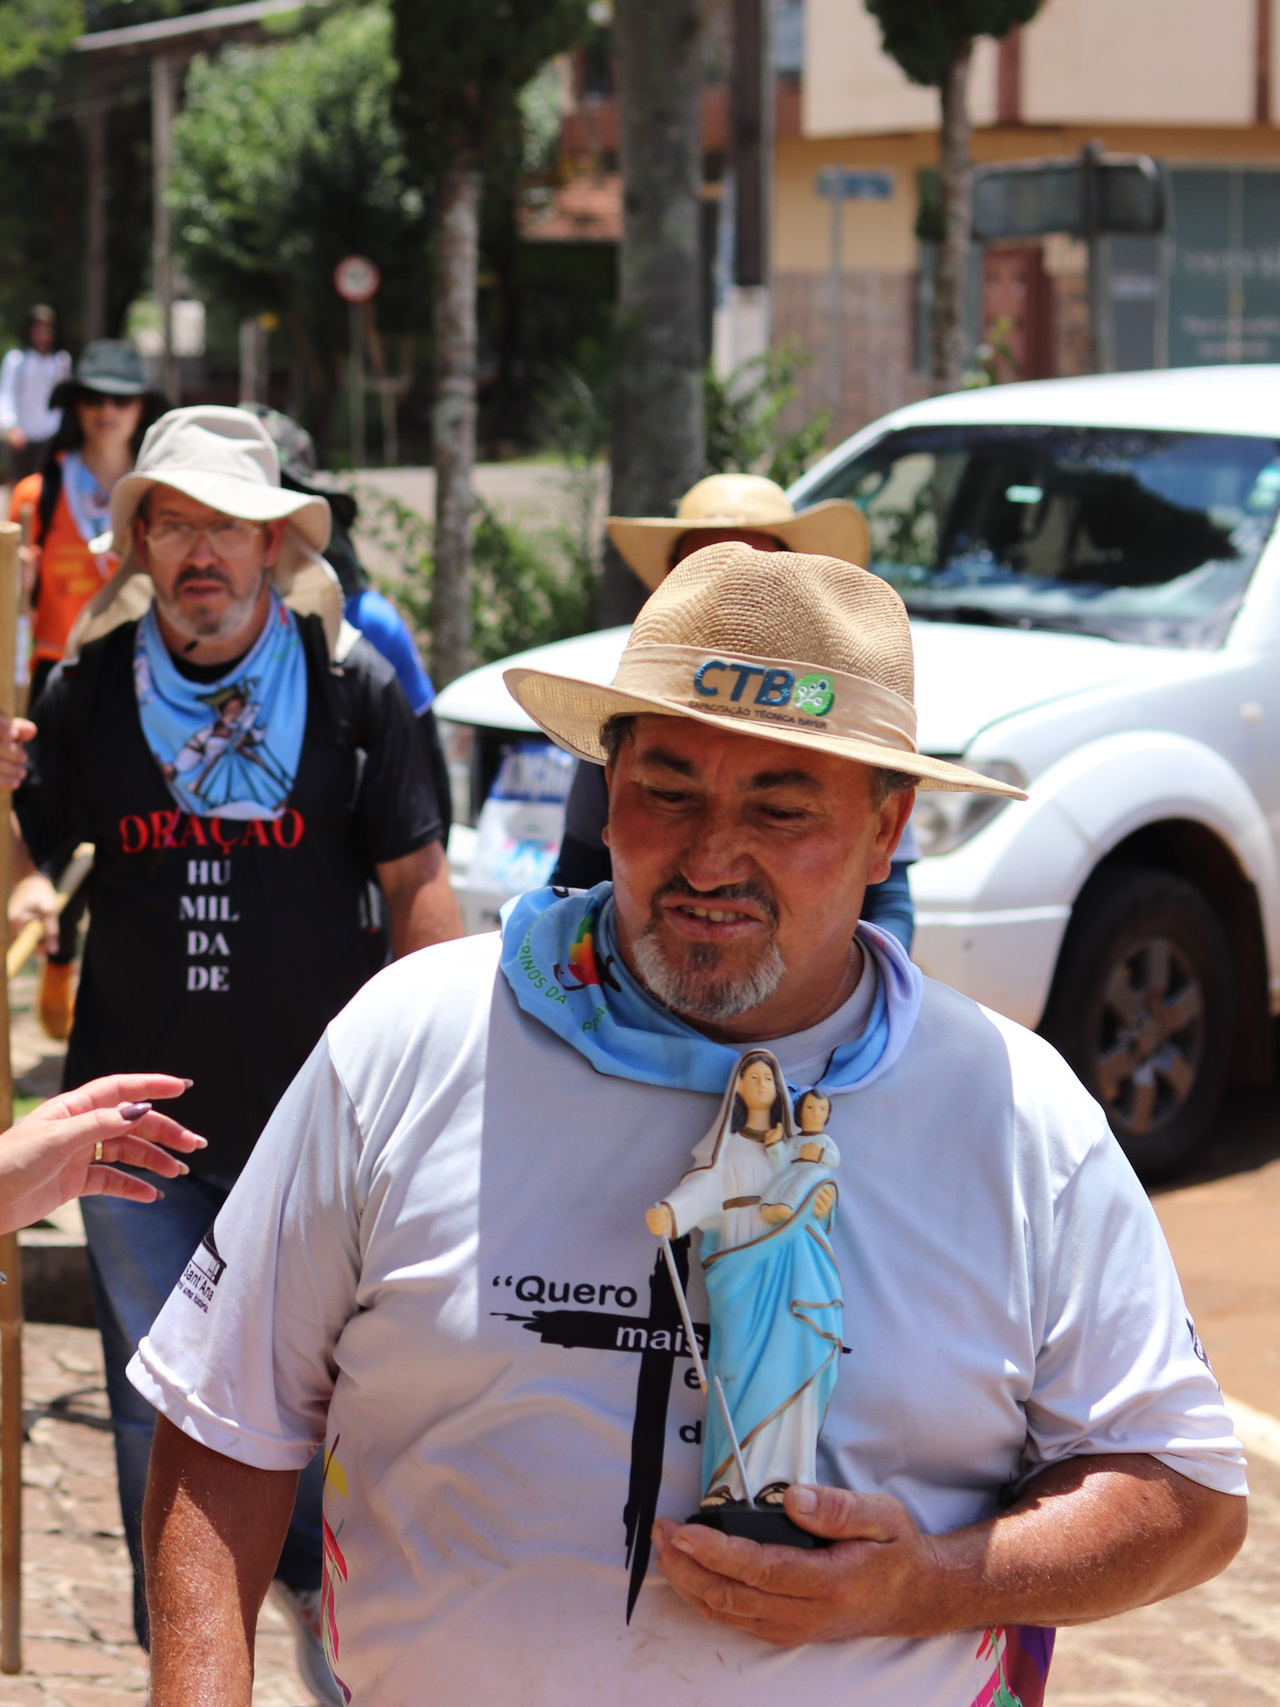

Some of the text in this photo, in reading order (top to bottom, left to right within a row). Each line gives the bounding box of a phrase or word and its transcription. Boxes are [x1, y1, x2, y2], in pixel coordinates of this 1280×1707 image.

[693, 659, 796, 707] CTB
[688, 700, 827, 730] CAPACITAÇÃO TÉCNICA BAYER
[187, 859, 231, 886] HU
[178, 895, 240, 922] MIL
[186, 930, 231, 956] DA
[186, 965, 230, 992] DE
[545, 985, 567, 1006] DA
[615, 1324, 705, 1354] mais
[679, 1420, 702, 1445] d
